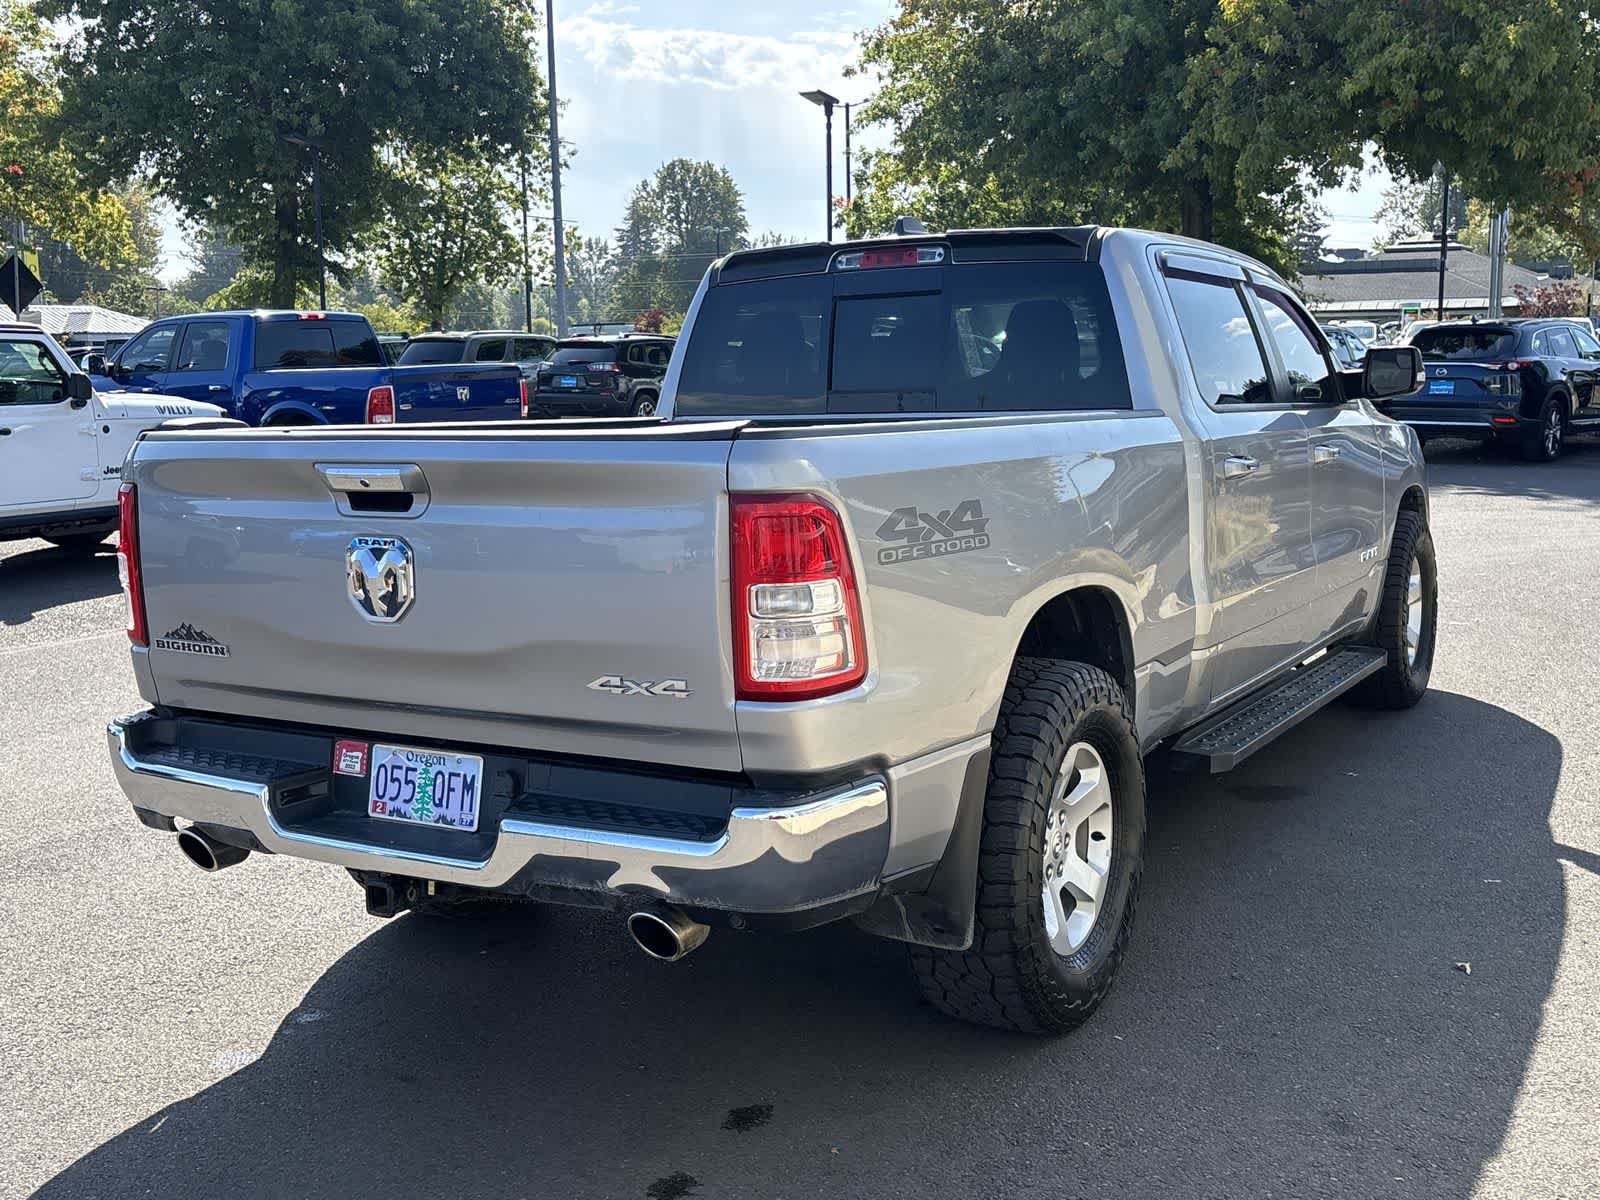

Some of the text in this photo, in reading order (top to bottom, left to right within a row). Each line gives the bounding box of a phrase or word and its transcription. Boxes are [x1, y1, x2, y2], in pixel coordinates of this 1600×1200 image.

[154, 404, 193, 415] WILLYS
[358, 538, 396, 547] RAM
[879, 535, 989, 563] OFF ROAD
[156, 639, 227, 656] BIGHORN
[406, 750, 446, 768] Oregon
[375, 763, 476, 813] 055 QFM
